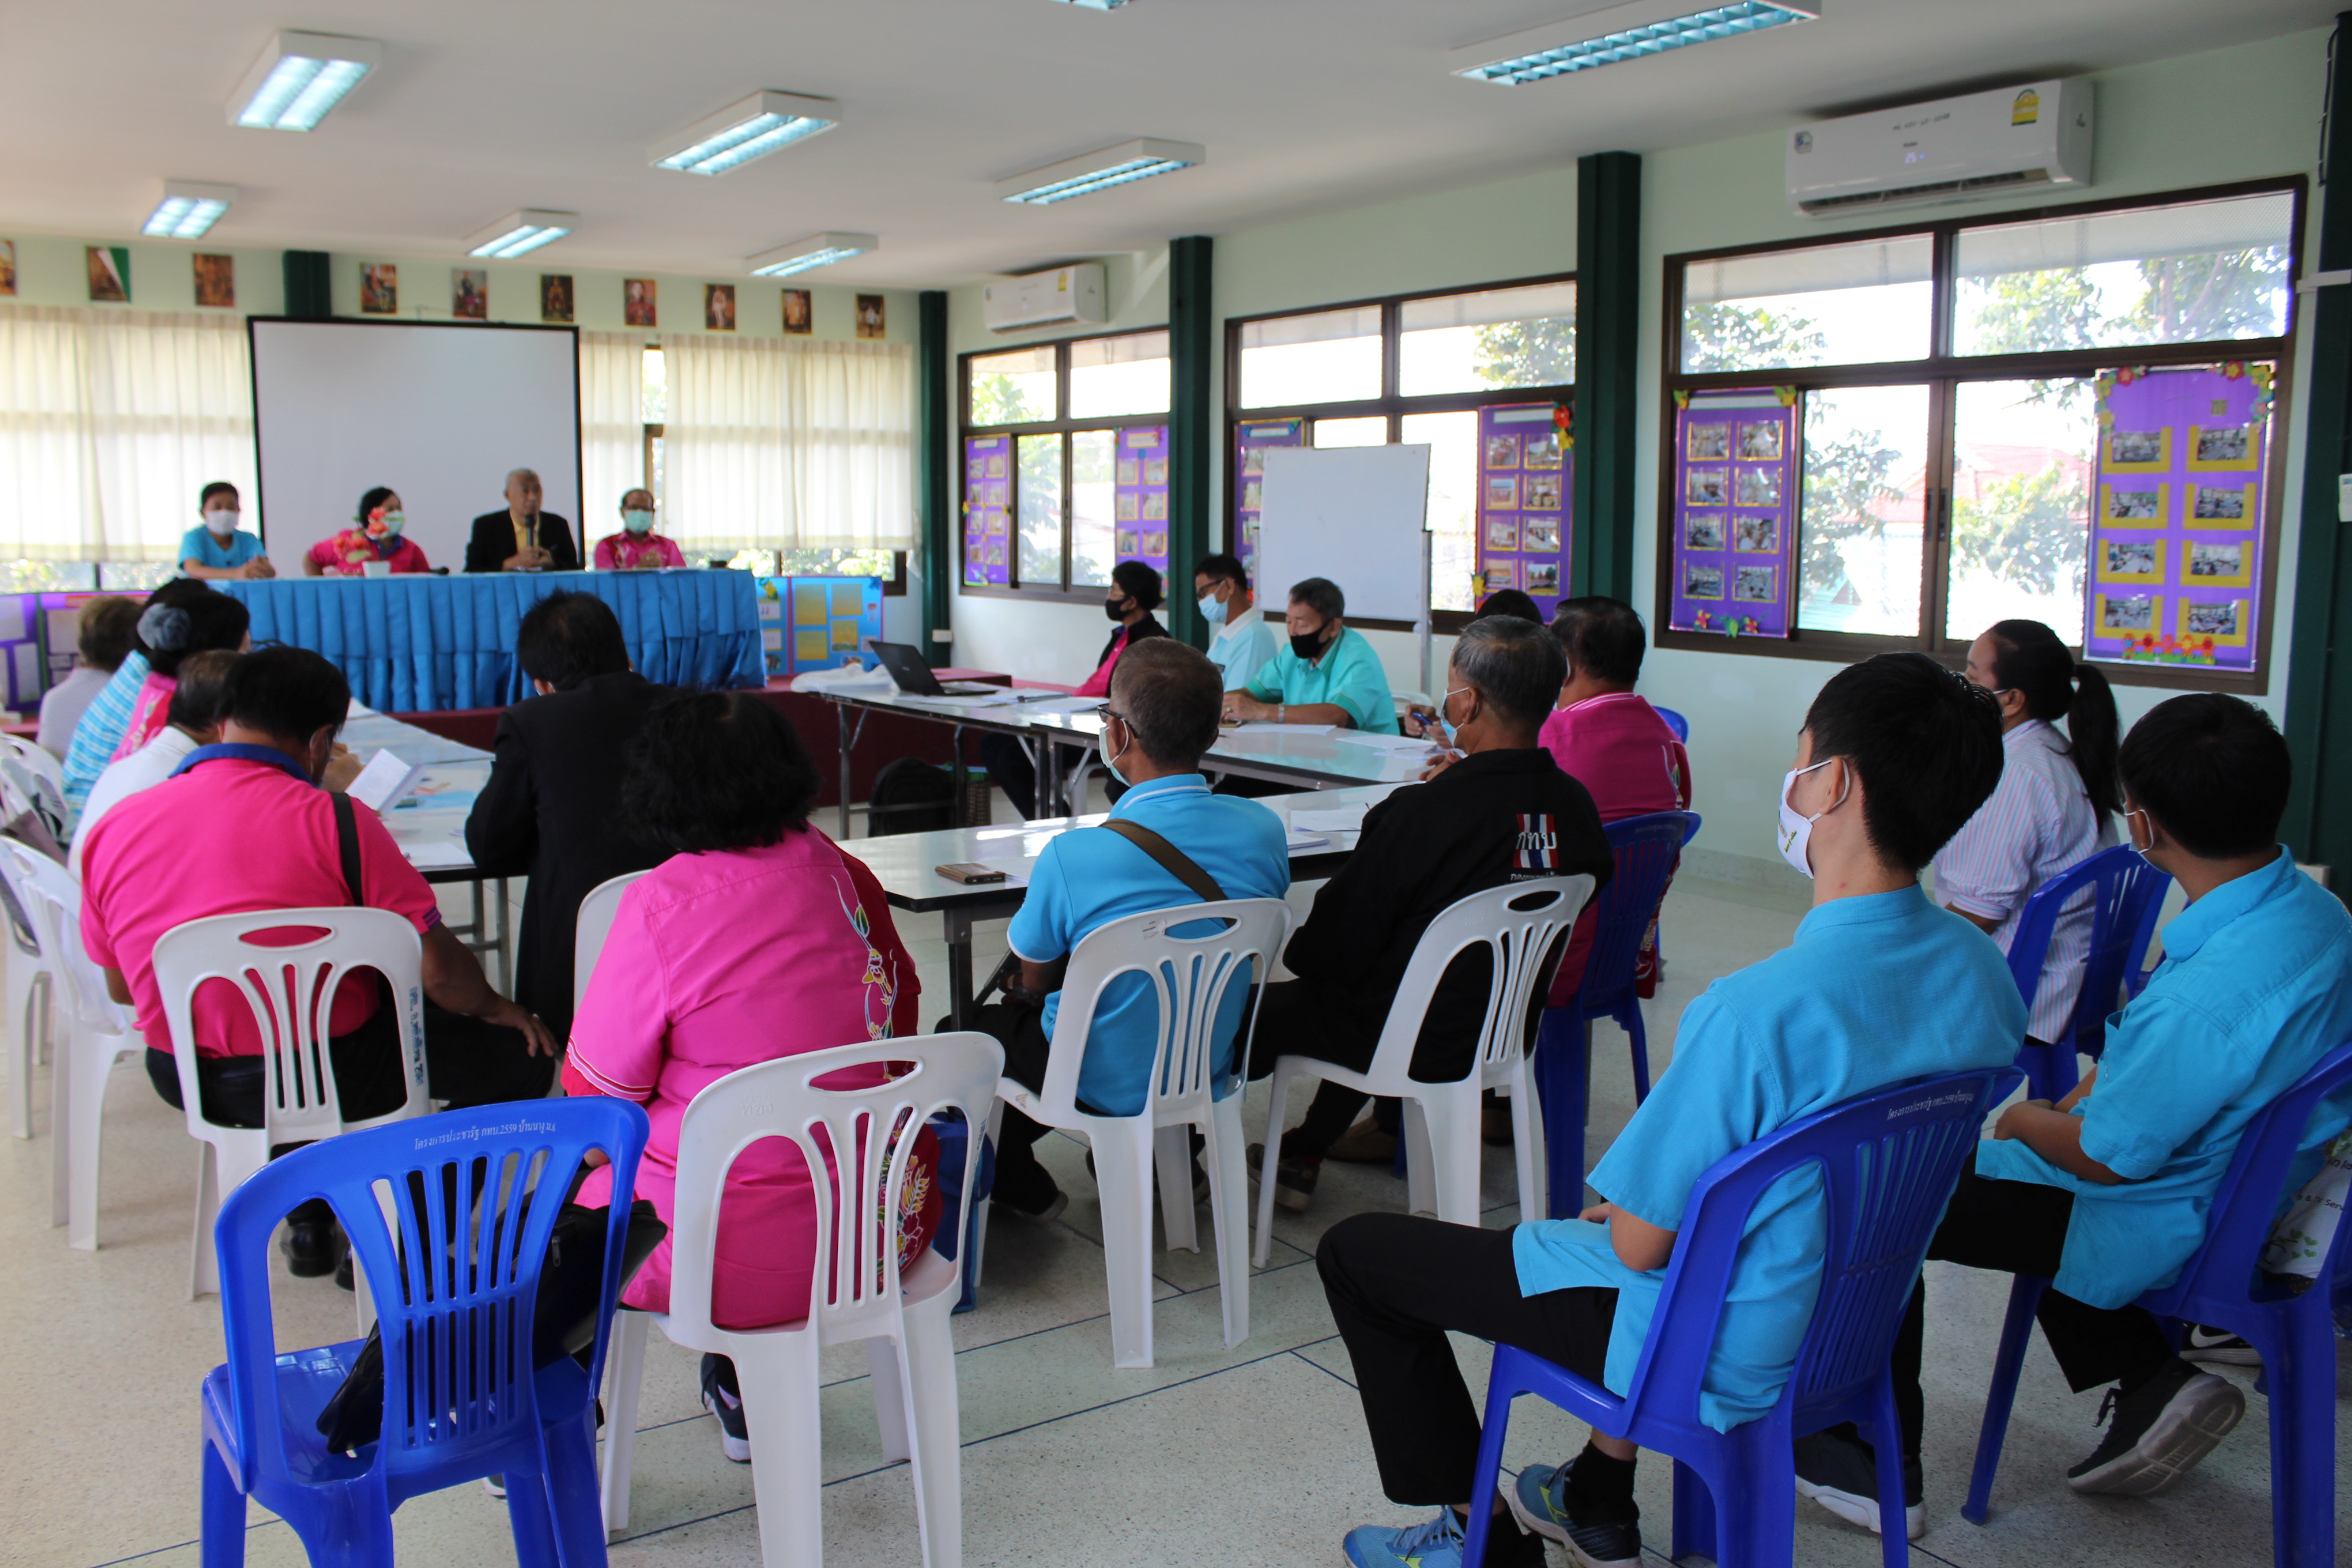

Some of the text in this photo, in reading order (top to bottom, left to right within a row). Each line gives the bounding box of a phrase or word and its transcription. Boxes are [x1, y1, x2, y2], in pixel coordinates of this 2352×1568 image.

[1516, 832, 1557, 849] กทบ
[481, 1124, 517, 1137] กทบ.2559
[2323, 1198, 2344, 1211] Serv
